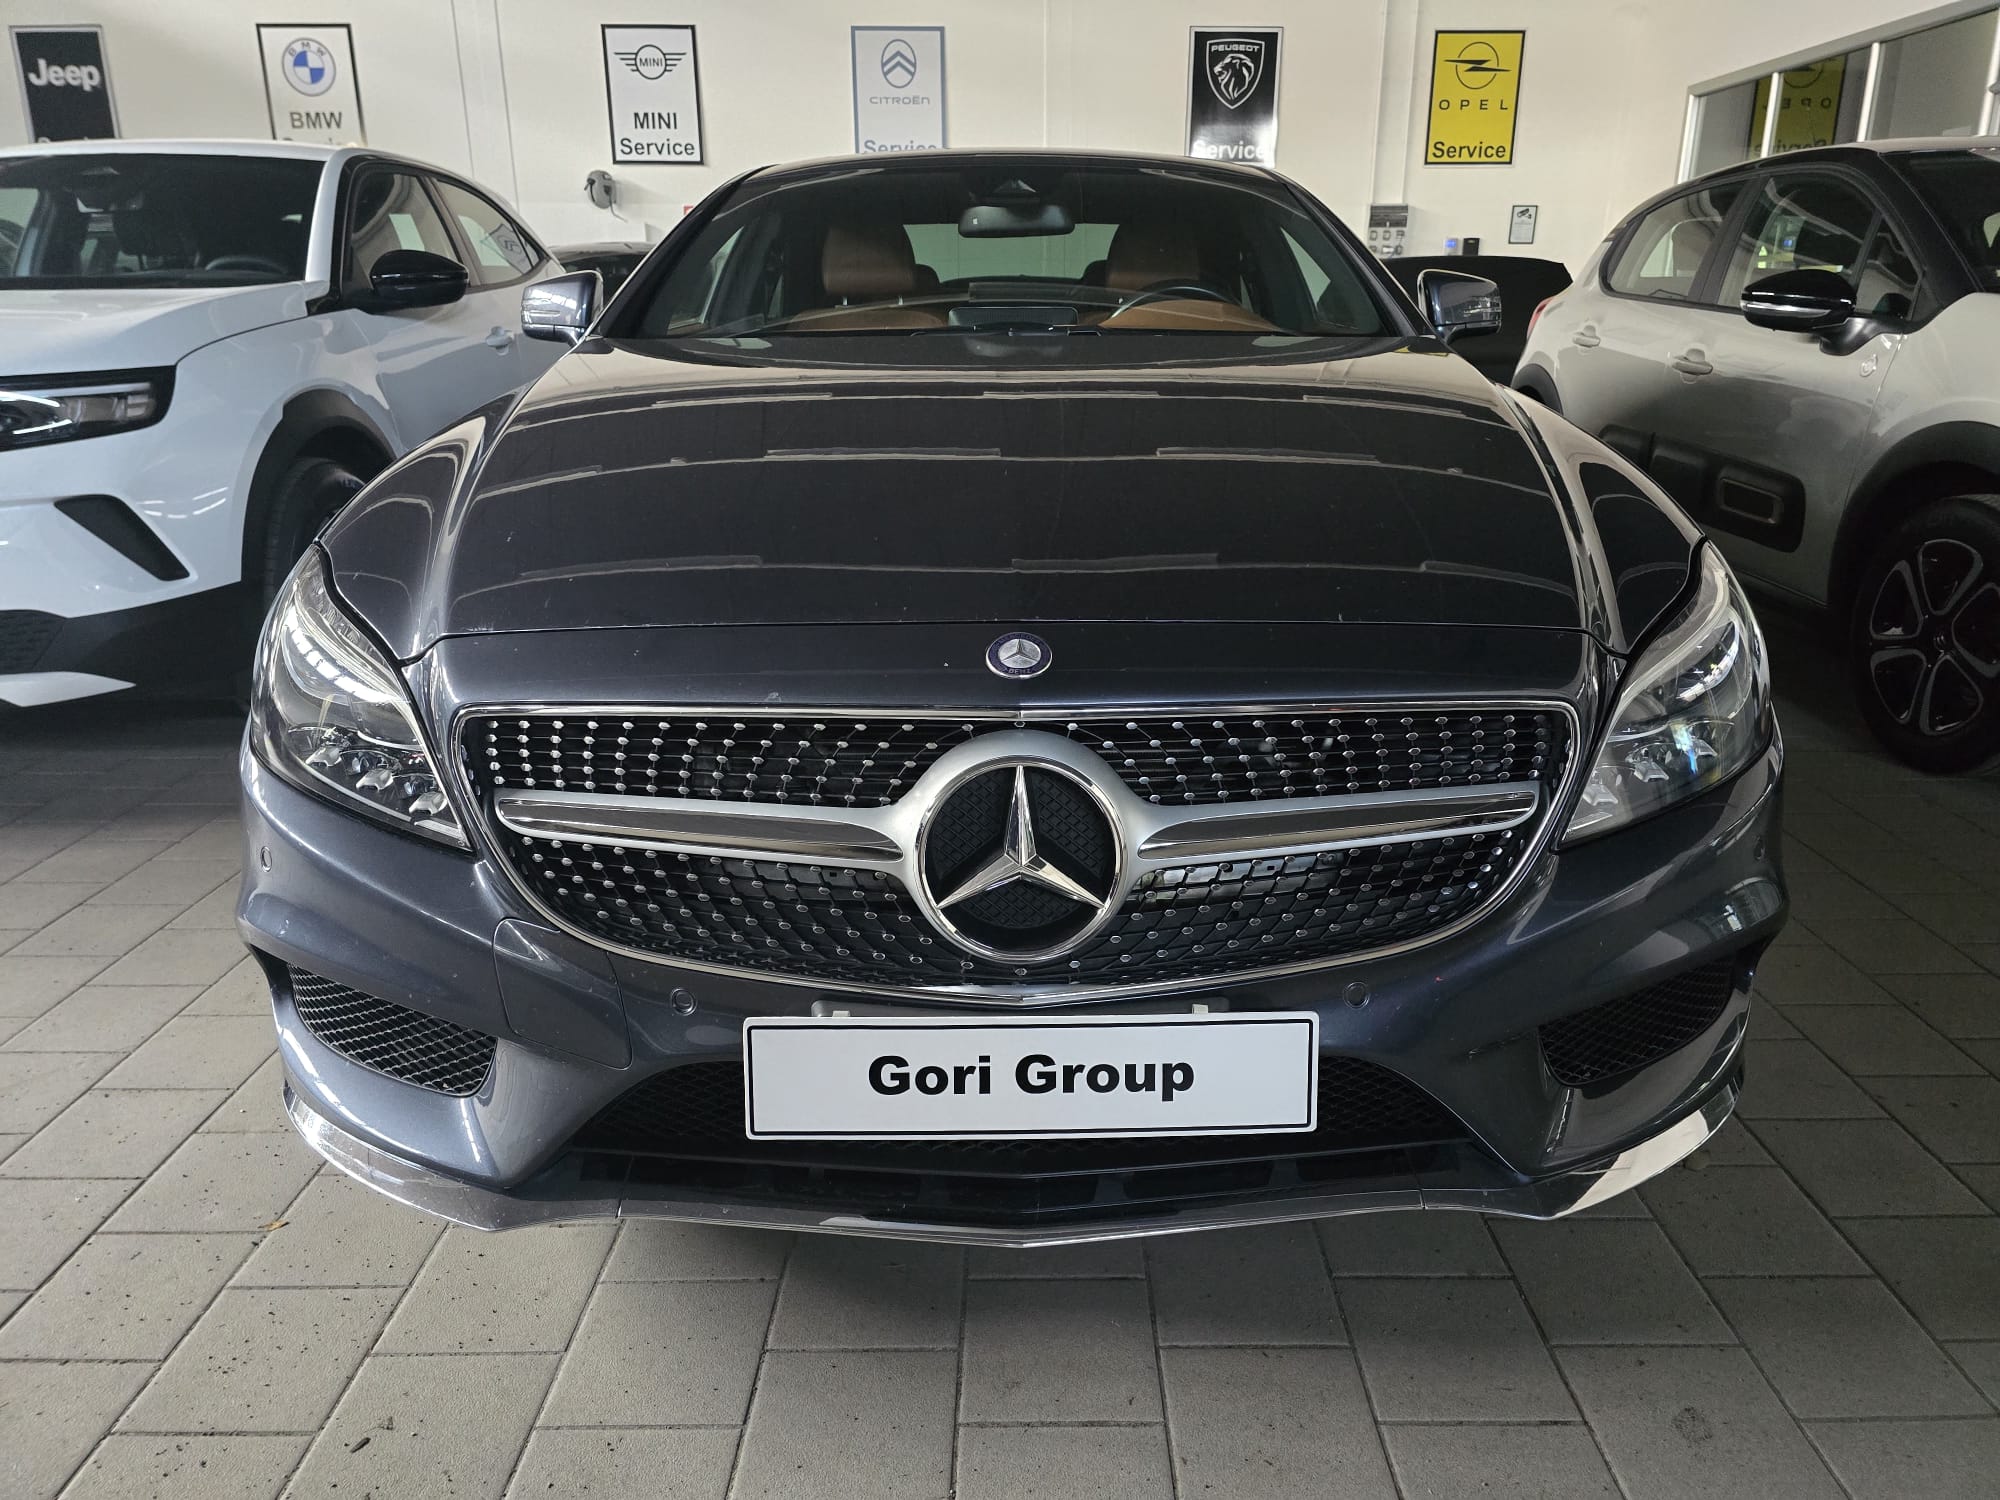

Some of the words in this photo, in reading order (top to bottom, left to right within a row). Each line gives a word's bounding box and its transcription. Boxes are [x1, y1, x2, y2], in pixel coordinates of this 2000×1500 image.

[288, 41, 326, 57] BMW
[1211, 44, 1260, 52] PEUGEOT
[639, 58, 663, 67] MINI
[28, 58, 101, 91] Jeep
[1439, 99, 1508, 110] OPEL
[290, 112, 342, 129] BMW
[634, 112, 678, 129] MINI
[620, 138, 695, 155] Service
[1432, 141, 1506, 158] Service
[869, 1055, 991, 1096] Gori
[1015, 1053, 1195, 1102] Group
